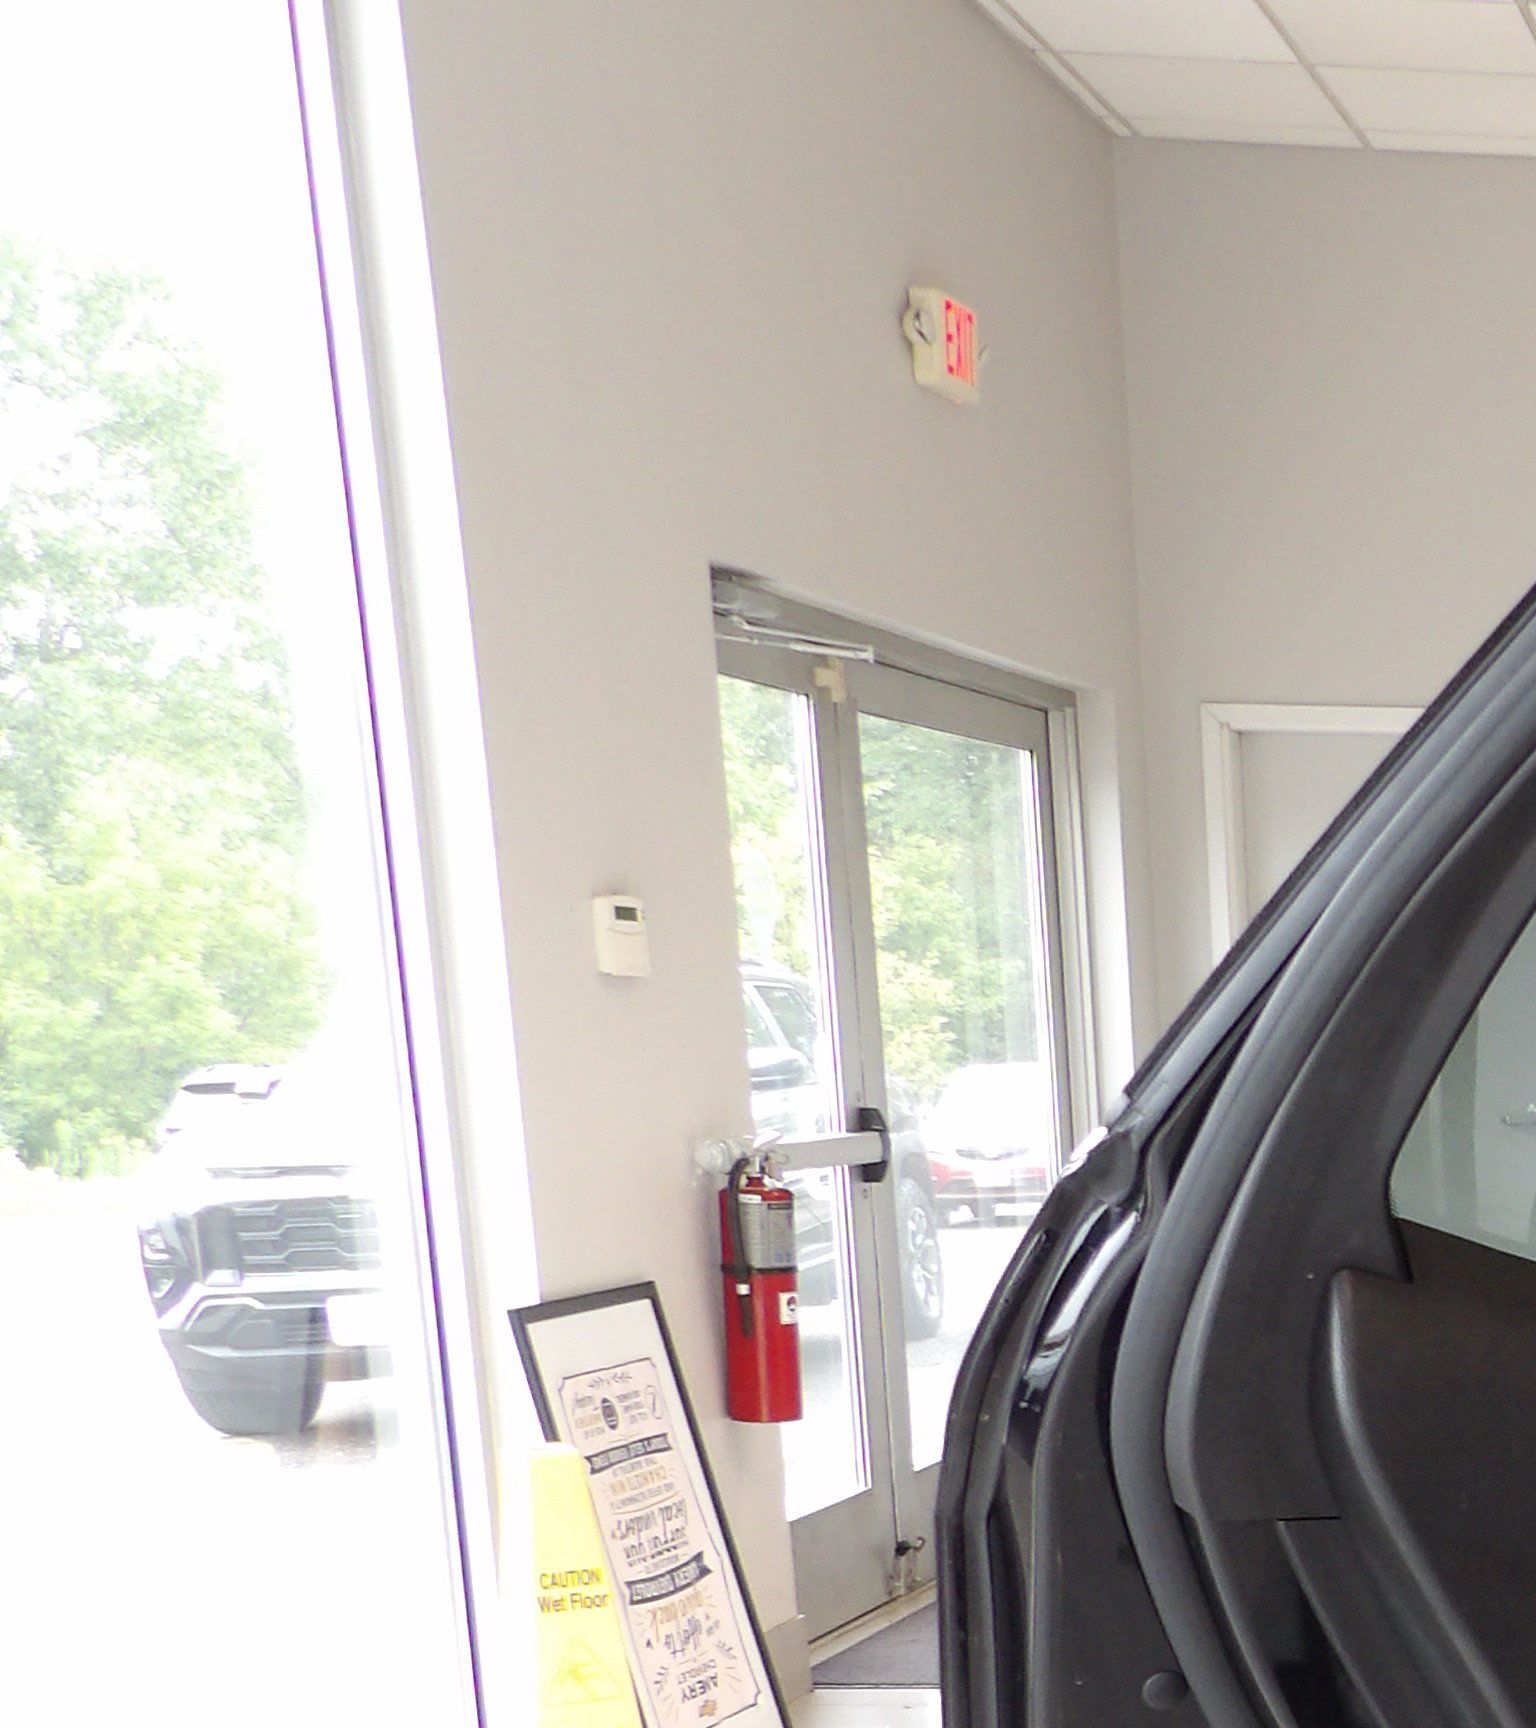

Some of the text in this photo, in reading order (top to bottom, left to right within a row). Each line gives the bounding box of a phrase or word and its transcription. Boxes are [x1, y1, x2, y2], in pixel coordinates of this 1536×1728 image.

[944, 300, 976, 386] EXIT
[539, 1569, 602, 1591] CAUTION
[537, 1592, 609, 1613] Wet Floor
